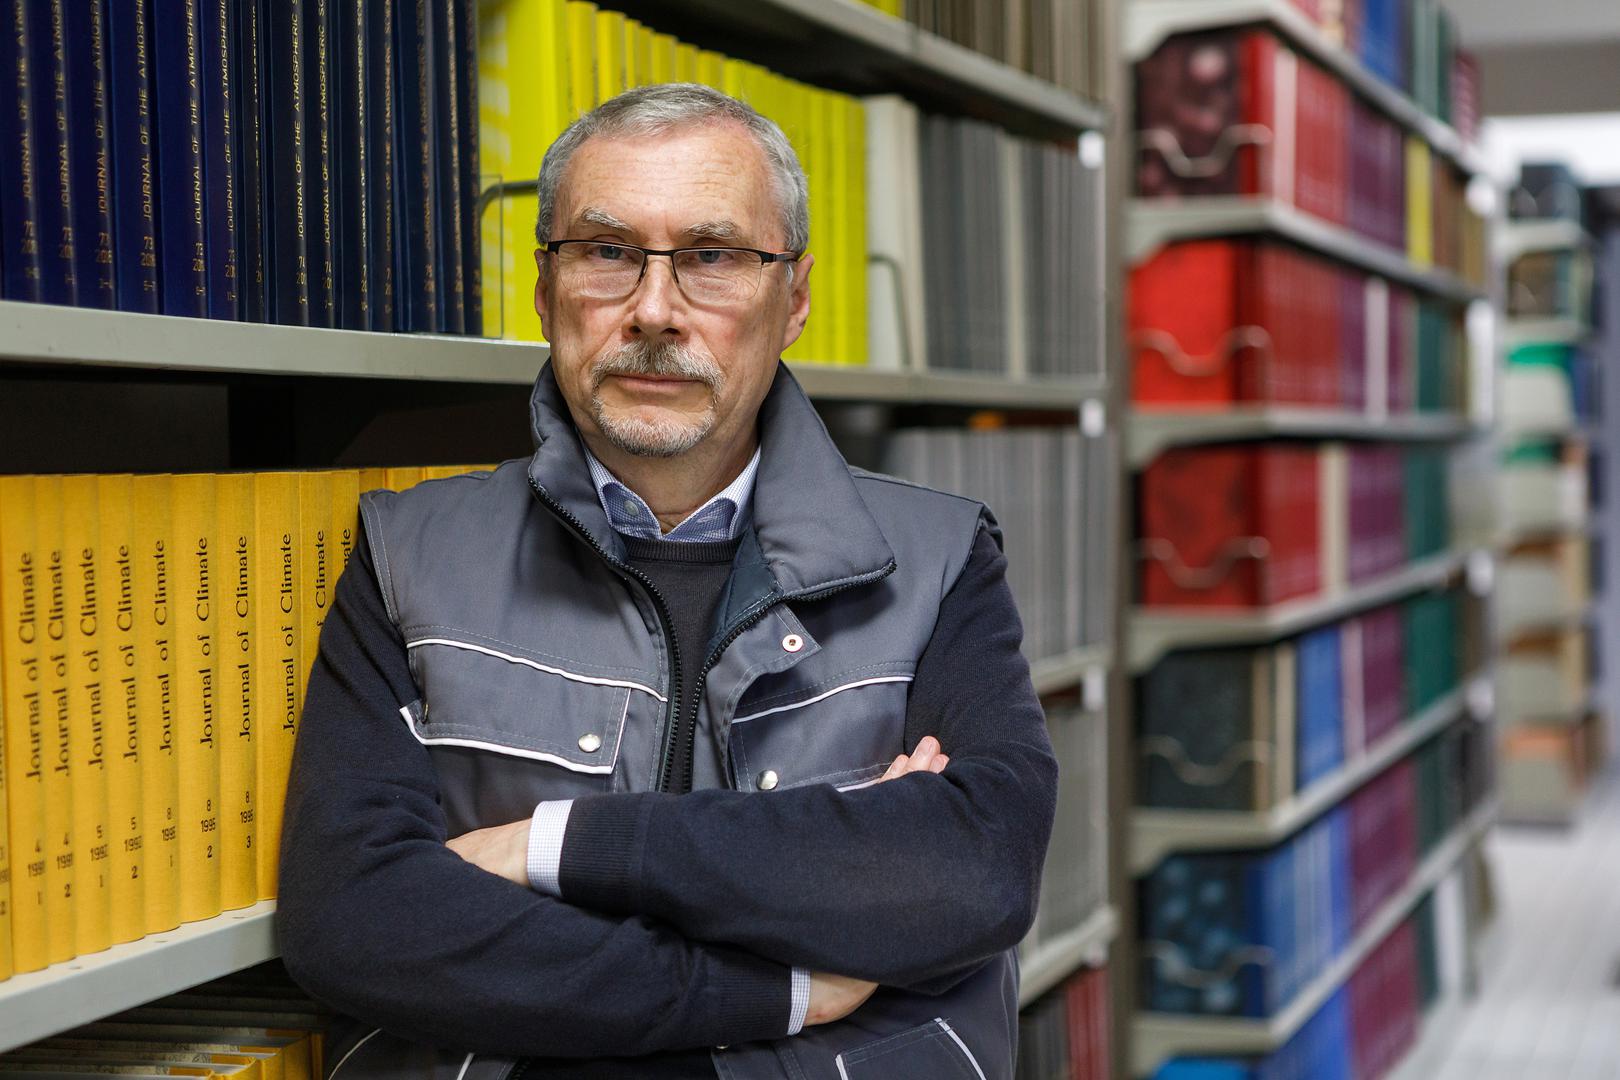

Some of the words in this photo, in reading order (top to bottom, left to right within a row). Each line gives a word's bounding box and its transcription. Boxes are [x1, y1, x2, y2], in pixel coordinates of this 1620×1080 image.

[291, 13, 300, 112] ATMOSPHERIC
[318, 25, 327, 121] ATMOSPHERIC
[55, 71, 64, 100] THE
[94, 80, 102, 107] THE
[138, 87, 148, 116] THE
[189, 96, 198, 126] THE
[57, 111, 66, 131] OF
[95, 118, 104, 138] OF
[140, 123, 149, 145] OF
[222, 108, 230, 136] THE
[191, 135, 199, 154] OF
[224, 143, 232, 164] OF
[320, 127, 328, 155] THE
[20, 129, 32, 199] JOURNAL
[60, 144, 71, 208] JOURNAL
[296, 153, 302, 174] OF
[322, 160, 329, 181] OF
[97, 148, 108, 213] JOURNAL
[142, 152, 153, 221] JOURNAL
[193, 165, 202, 227] JOURNAL
[226, 175, 234, 233] JOURNAL
[295, 182, 304, 239] JOURNAL
[322, 186, 331, 247] JOURNAL
[144, 236, 154, 250] 73
[153, 540, 168, 626] Climate
[195, 537, 209, 622] Climate
[235, 536, 249, 618] Climate
[280, 533, 293, 613] Climate
[315, 530, 326, 609] Climate
[19, 552, 35, 644] Climate
[48, 550, 64, 640] Climate
[80, 547, 97, 636] Climate
[116, 545, 133, 631] Climate
[155, 640, 169, 661] of
[197, 635, 210, 657] of
[236, 631, 249, 652] of
[281, 626, 294, 647] of
[21, 658, 38, 682] of
[50, 655, 66, 677] of
[82, 650, 99, 672] of
[118, 645, 134, 667] of
[198, 668, 212, 749] Journal
[238, 663, 250, 742] Journal
[282, 658, 296, 735] Journal
[85, 682, 104, 770] Journal
[121, 677, 138, 763] Journal
[157, 673, 171, 756] Journal
[23, 692, 41, 783] Journal
[52, 688, 70, 777] Journal
[206, 799, 212, 812] 8
[246, 791, 251, 803] 8
[130, 816, 137, 830] 5
[166, 807, 173, 820] 8
[201, 818, 216, 833] 1995
[240, 809, 254, 823] 1995
[63, 832, 70, 846] 4
[96, 824, 103, 839] 5
[246, 835, 252, 849] 3
[207, 845, 213, 858] 2
[131, 865, 138, 879] 2
[64, 883, 71, 898] 2
